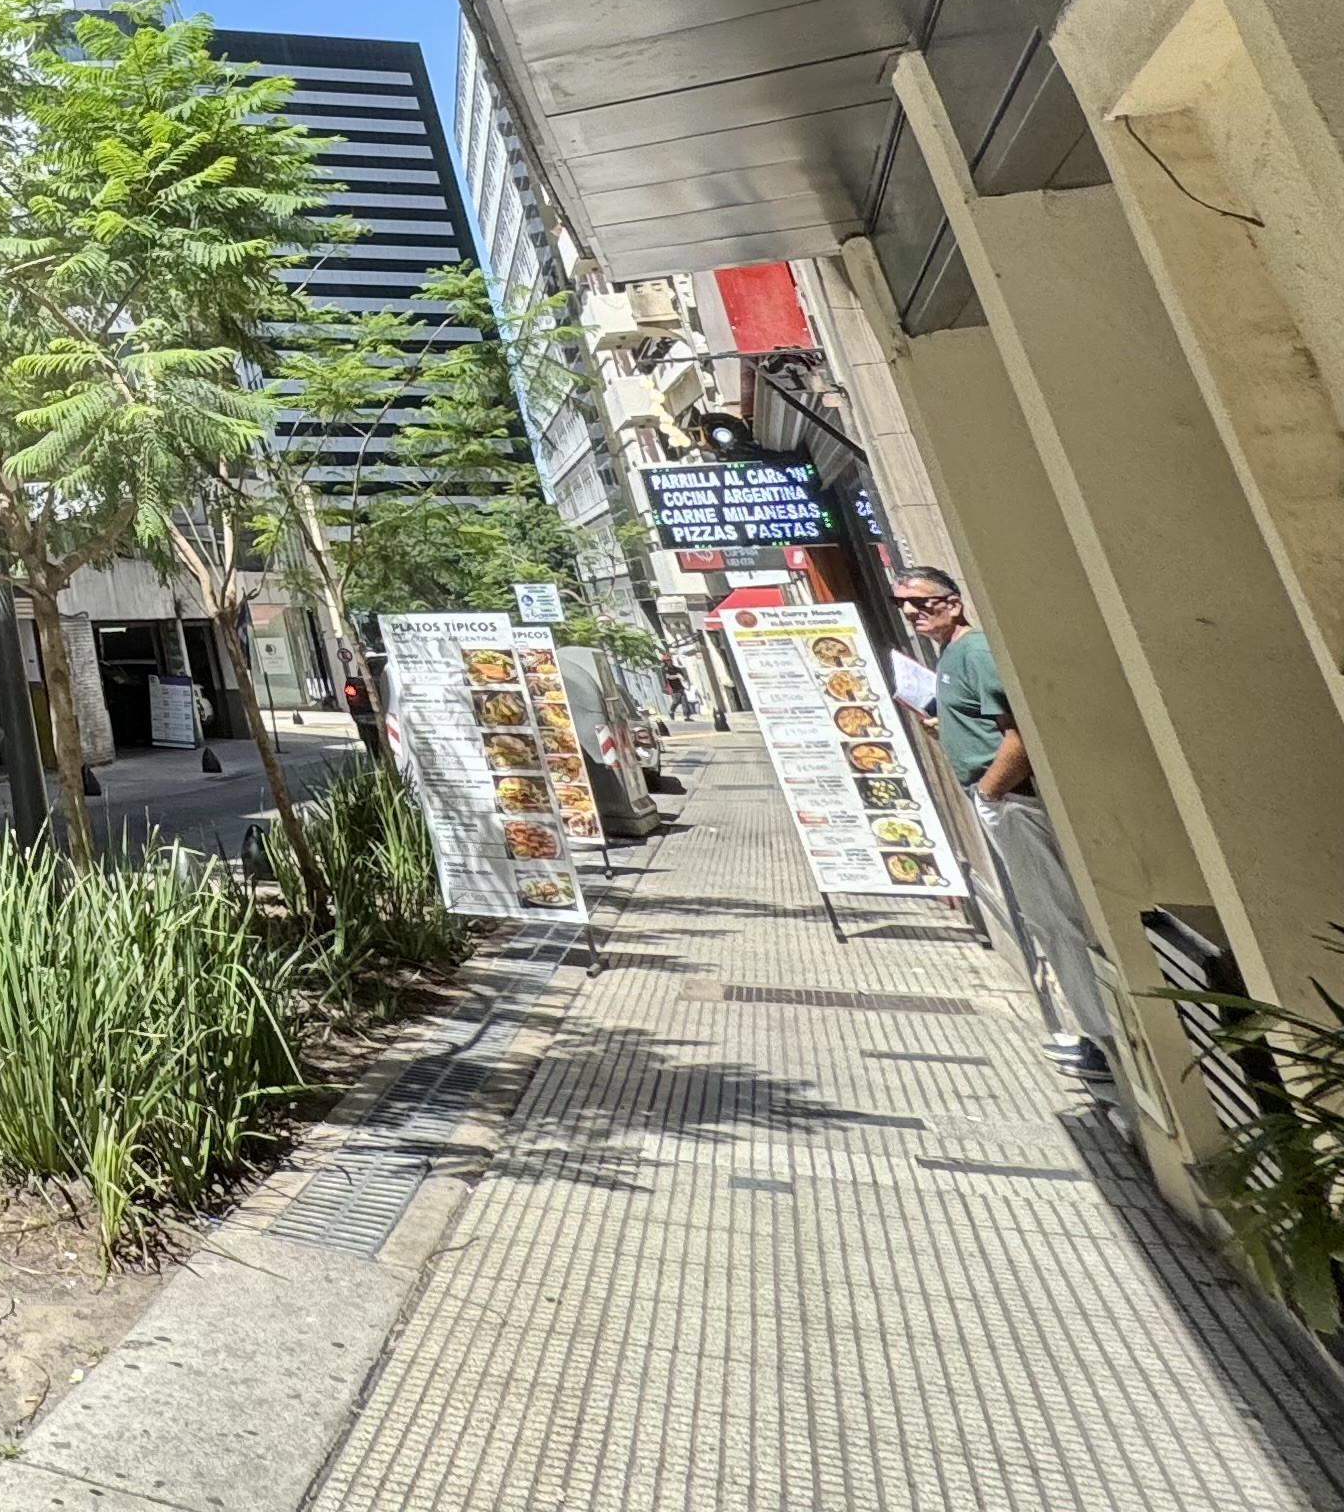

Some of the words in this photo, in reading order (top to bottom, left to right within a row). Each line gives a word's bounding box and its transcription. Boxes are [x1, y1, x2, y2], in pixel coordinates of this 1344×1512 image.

[650, 471, 721, 490] PARRILLA
[724, 470, 744, 486] AL
[663, 490, 718, 508] COCINA
[723, 486, 809, 504] ARGENTINA
[661, 507, 719, 526] CARNE
[722, 502, 821, 522] MILANESAS
[673, 524, 738, 543] PIZZAS
[745, 522, 819, 540] PASTAS
[391, 622, 441, 632] PLATOS
